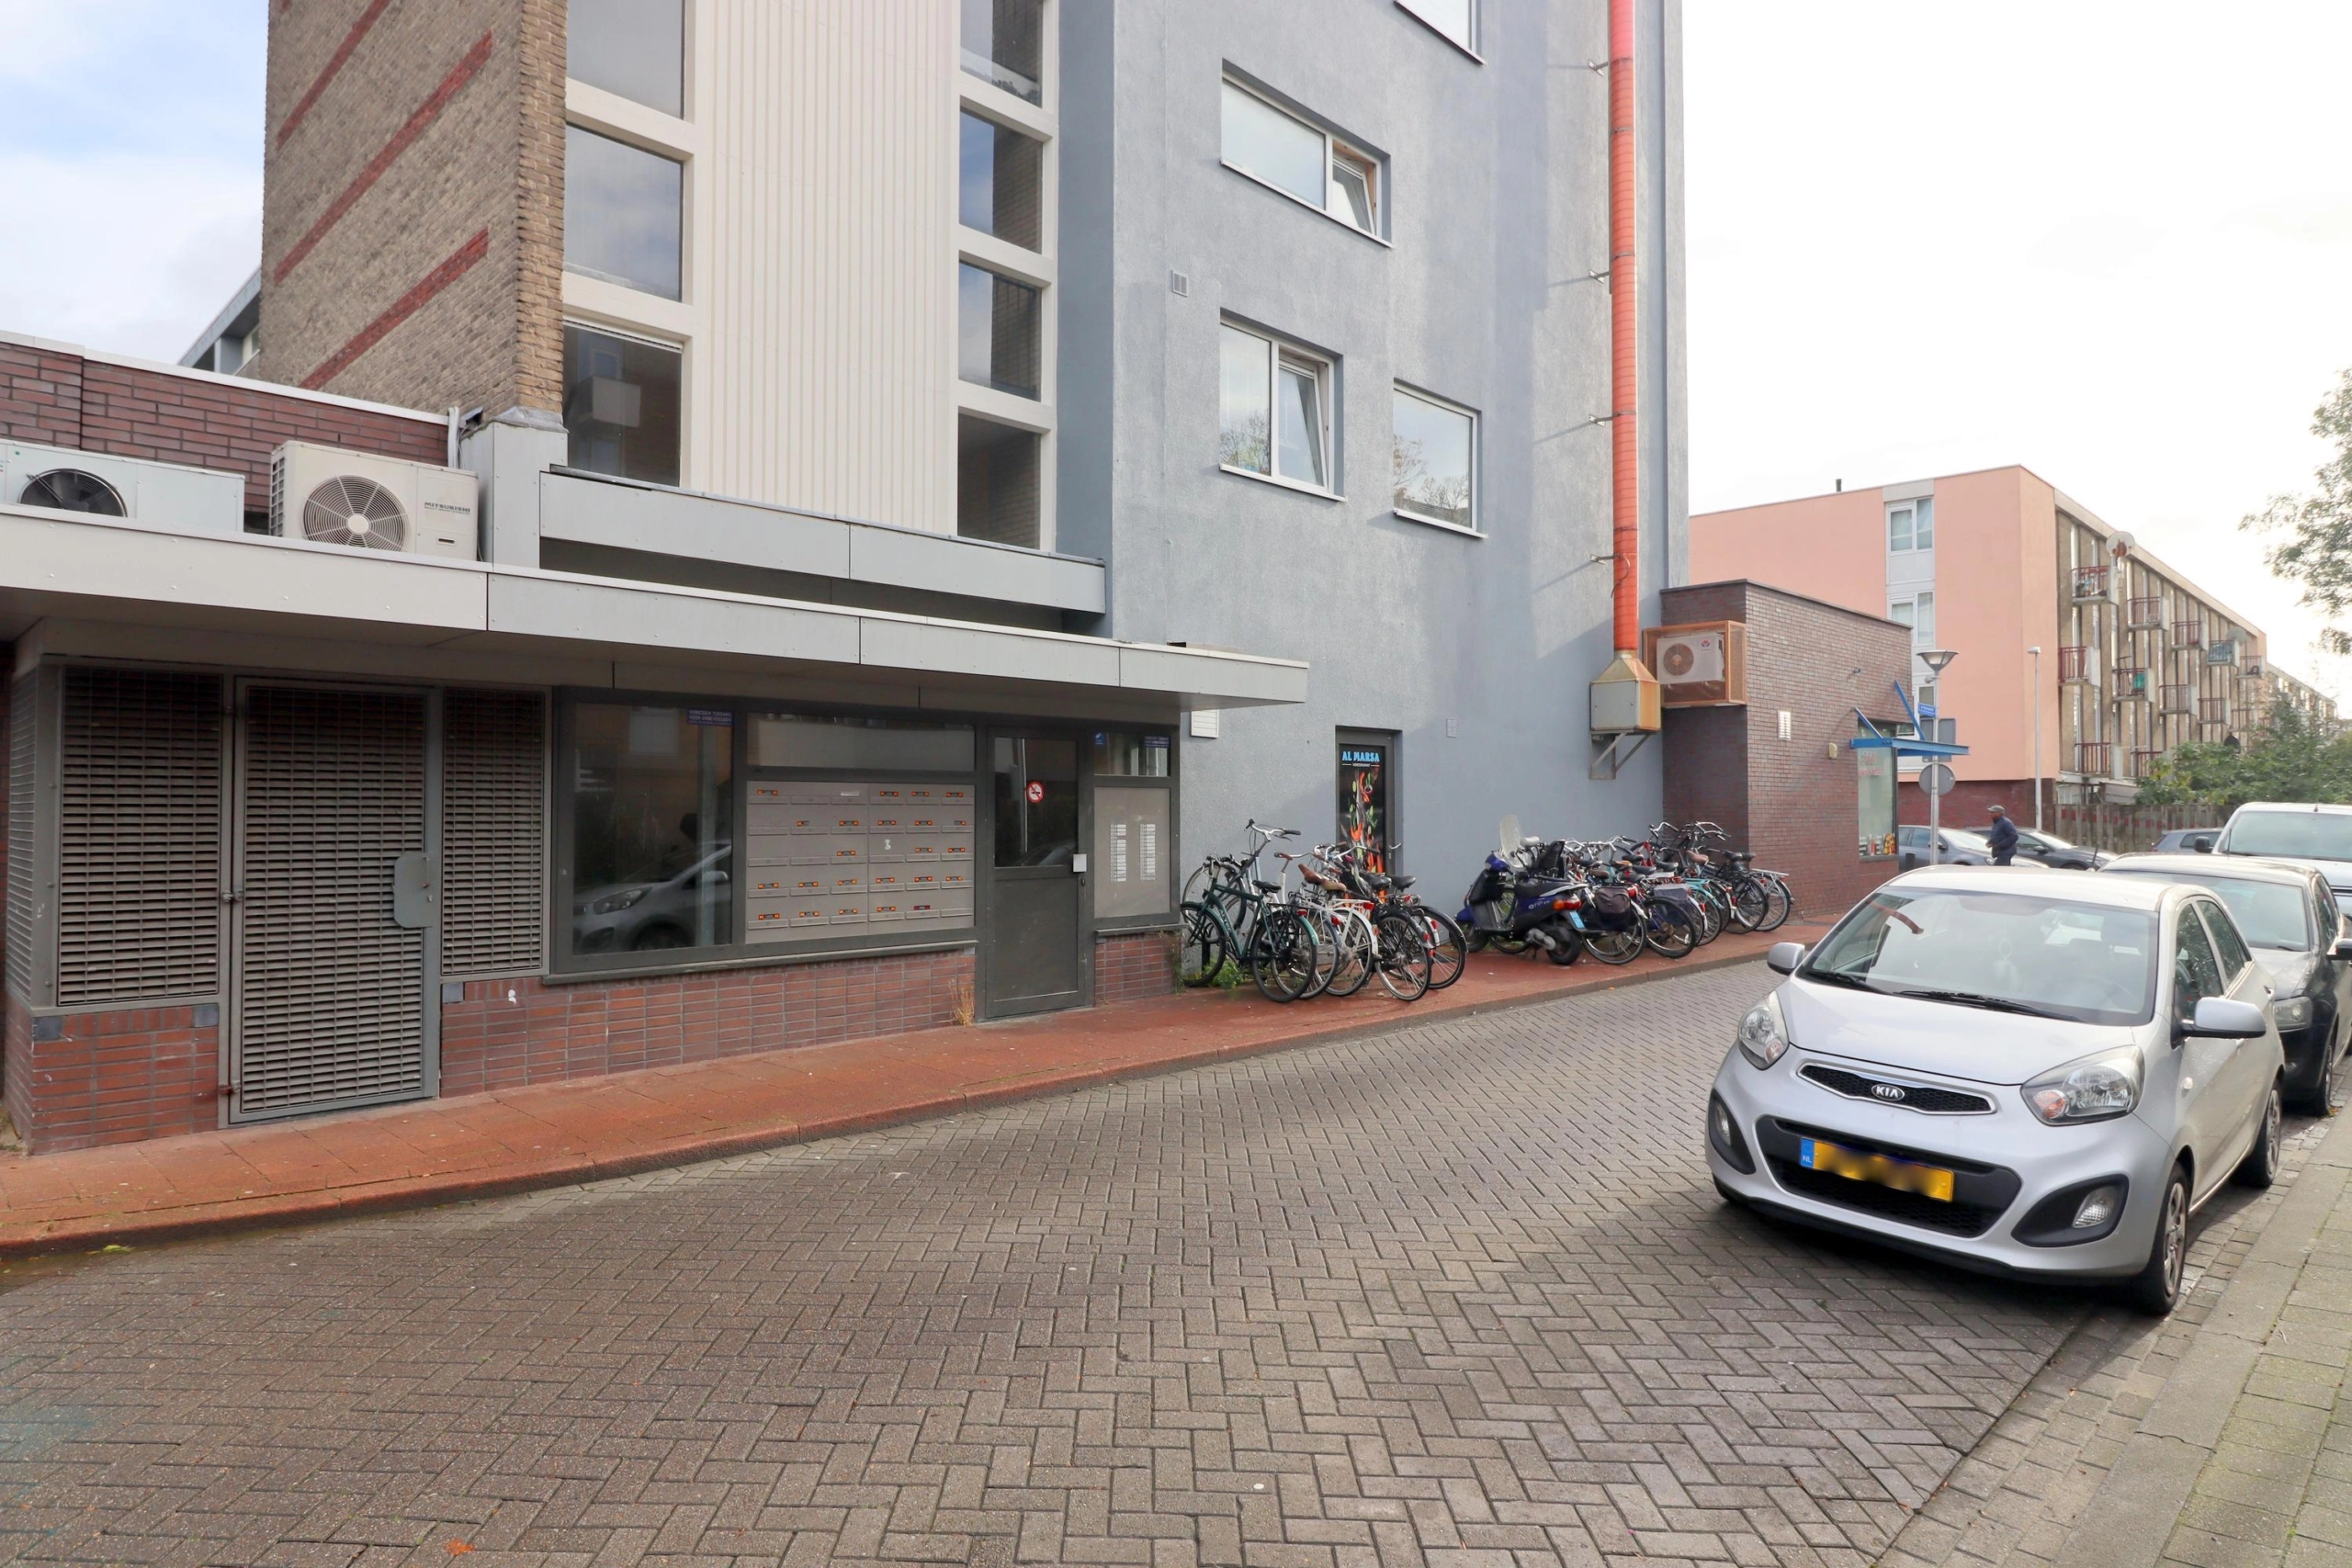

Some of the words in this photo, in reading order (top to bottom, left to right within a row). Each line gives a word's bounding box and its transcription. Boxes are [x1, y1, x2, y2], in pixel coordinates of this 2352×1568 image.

[424, 502, 470, 513] MITSUBISHI
[1341, 750, 1352, 761] AL
[1352, 751, 1380, 762] MARSA
[1875, 1085, 1899, 1099] KIA
[1803, 1155, 1812, 1164] NL
